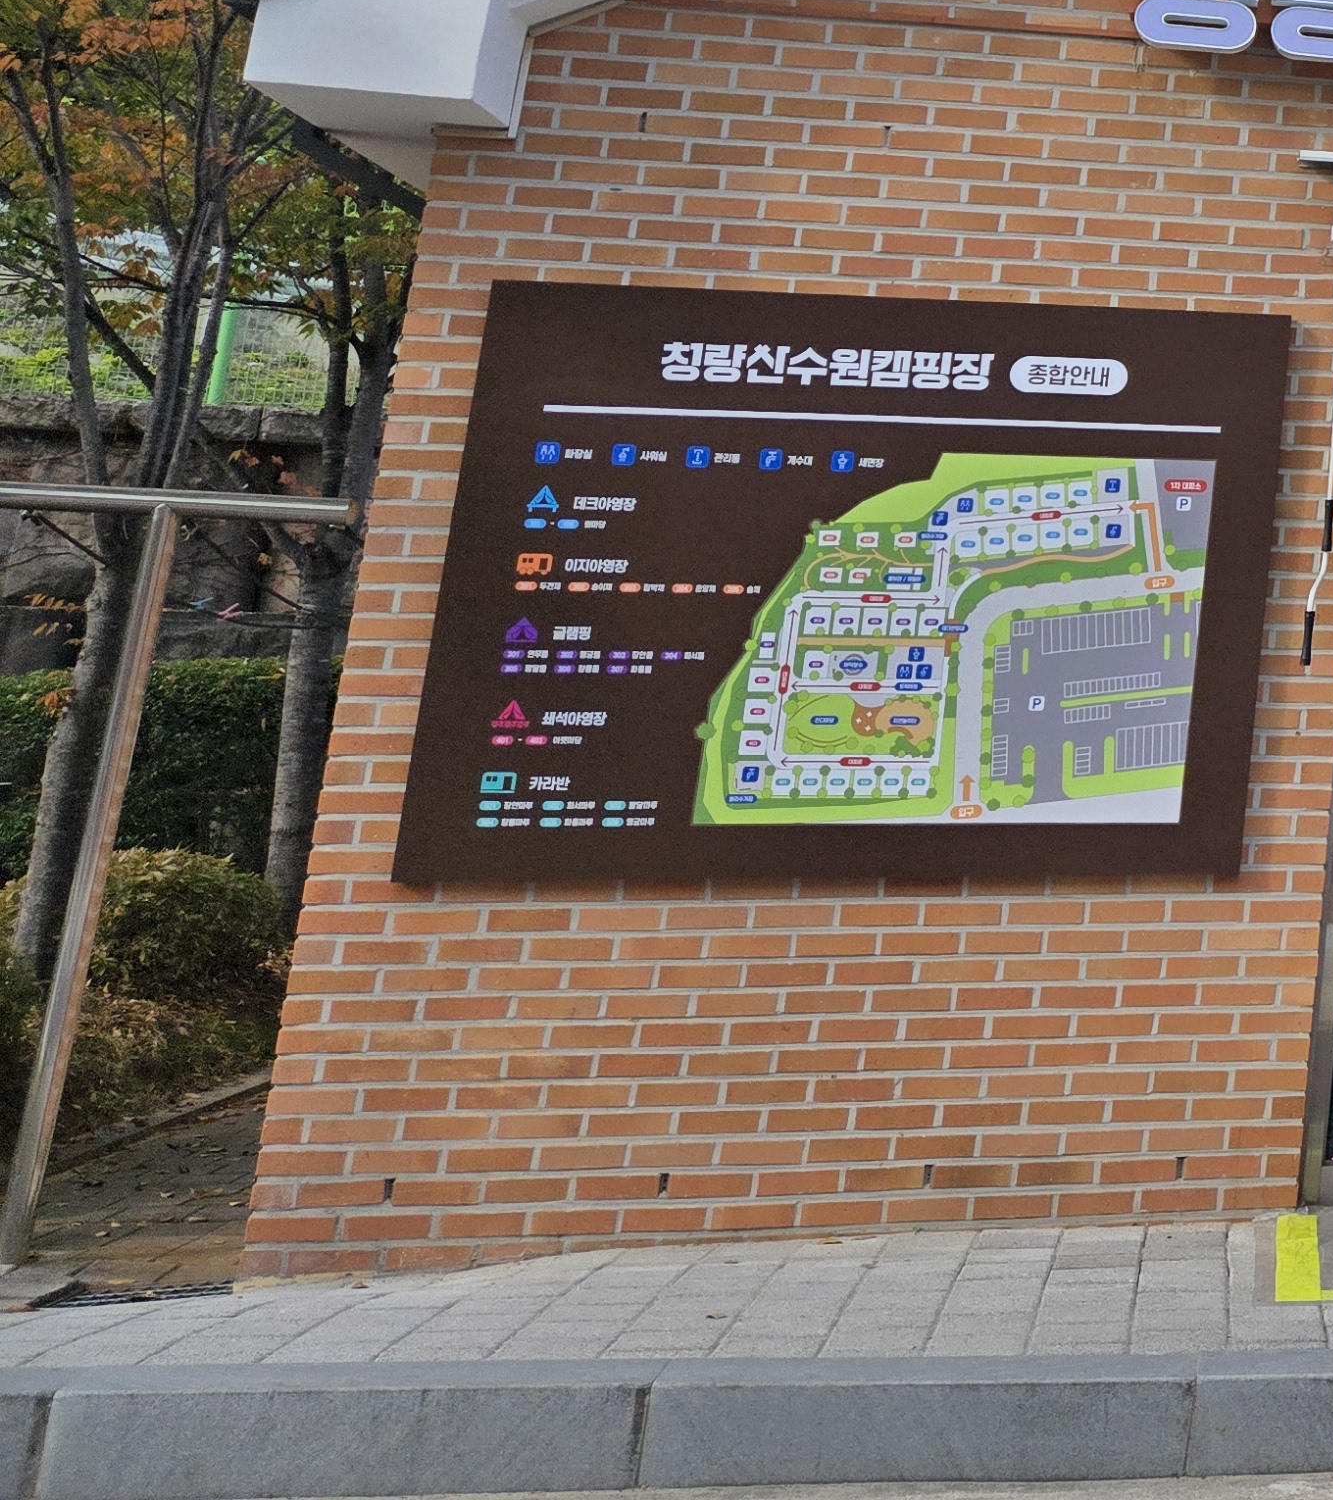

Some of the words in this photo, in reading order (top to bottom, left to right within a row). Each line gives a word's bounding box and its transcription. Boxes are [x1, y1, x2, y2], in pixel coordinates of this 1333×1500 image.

[661, 341, 994, 391] 청량산수원캠핑장
[1027, 364, 1110, 388] 종합안내
[564, 448, 593, 461] 화장실
[640, 450, 667, 463] 샤워실
[714, 452, 741, 465] 관리동
[787, 455, 813, 467] 개수대
[573, 496, 637, 512] 데크야영장
[564, 558, 630, 574] 이지야영장
[553, 626, 592, 641] 글램핑
[541, 711, 607, 727] 쇄석야영장
[528, 775, 571, 791] 카라반
